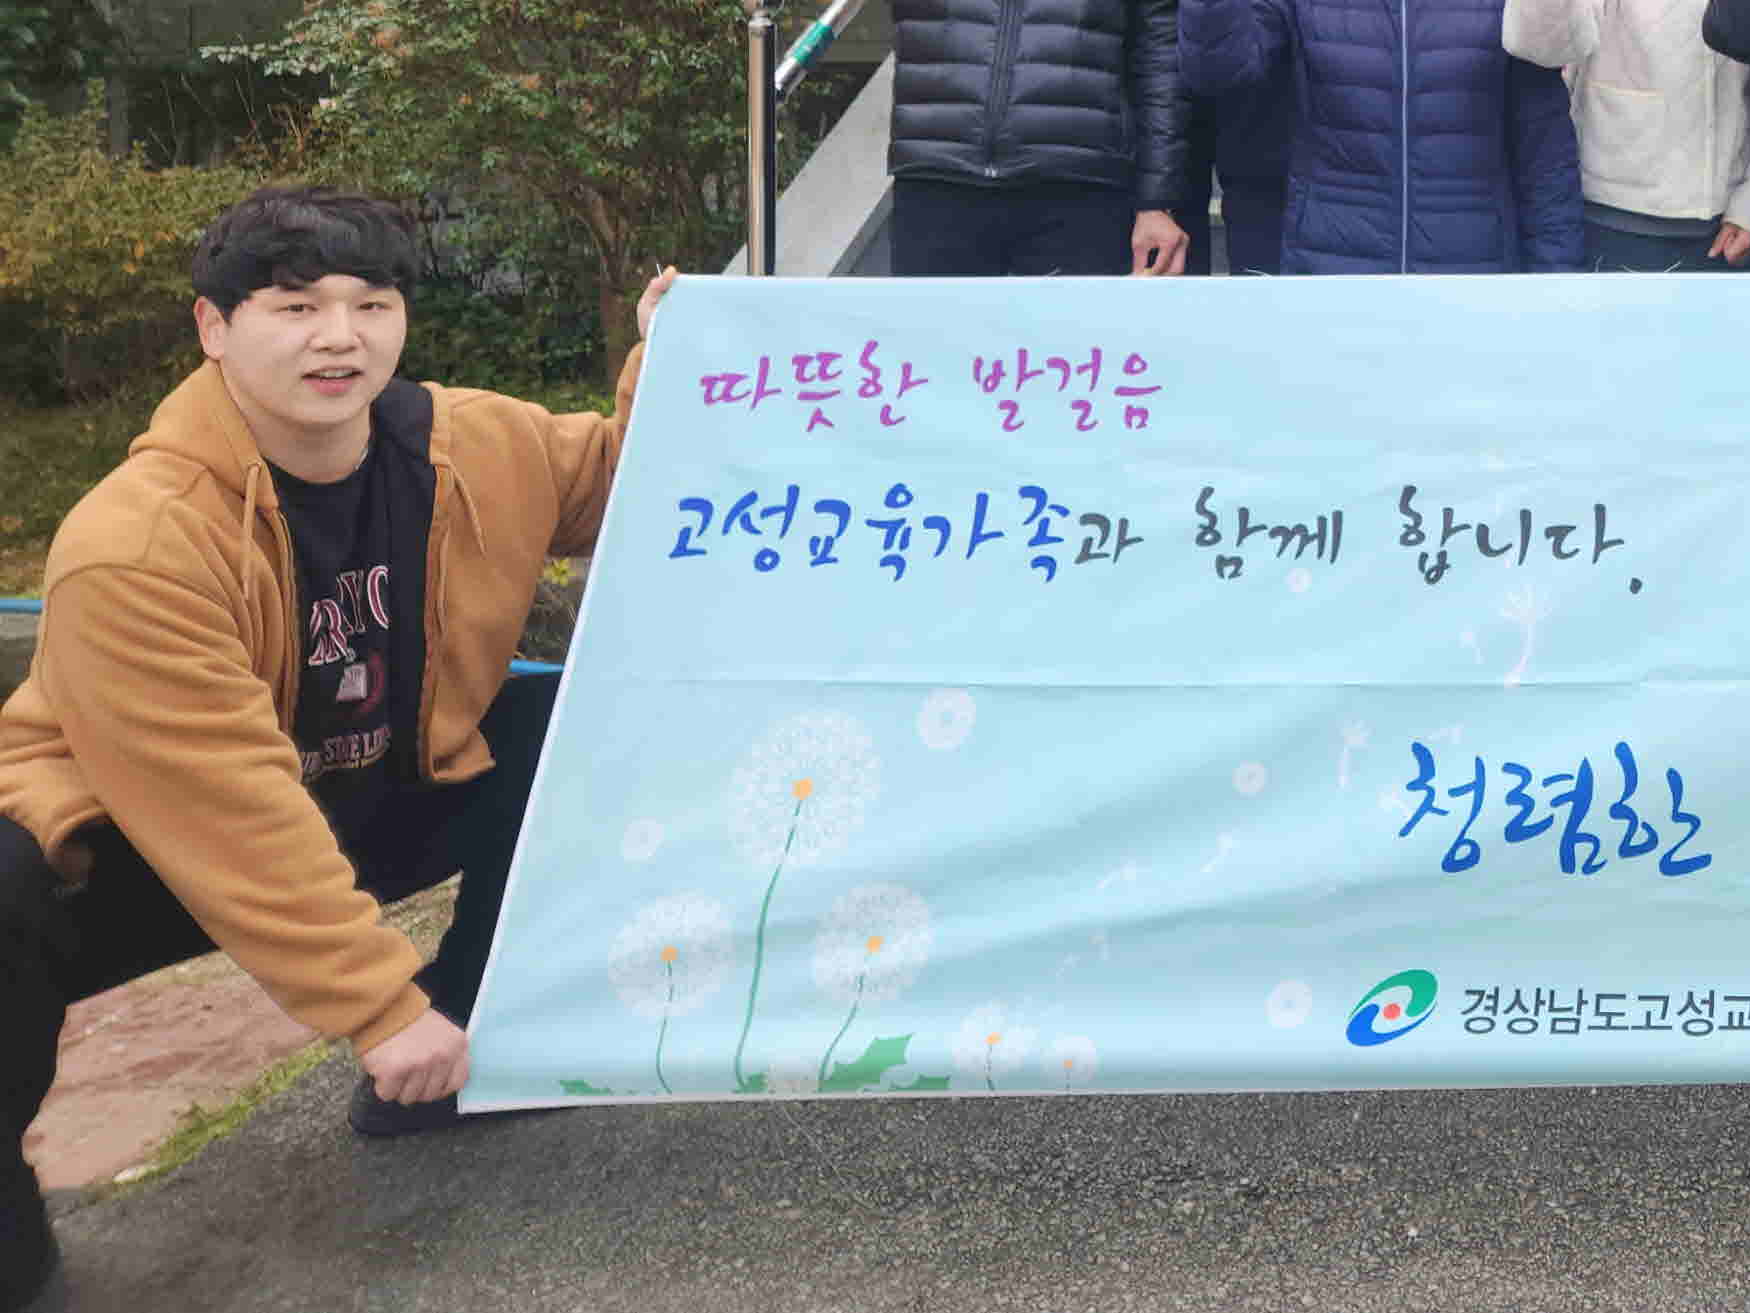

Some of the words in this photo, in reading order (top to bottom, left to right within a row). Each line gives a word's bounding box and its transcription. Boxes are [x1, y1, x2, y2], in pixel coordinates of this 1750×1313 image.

[701, 340, 928, 432] 따뜻한
[973, 347, 1163, 432] 발걸음
[668, 482, 1145, 582] 고성교육가족과
[1195, 485, 1344, 579] 함께
[1399, 485, 1644, 595] 합니다.
[1399, 741, 1713, 877] 청렴한
